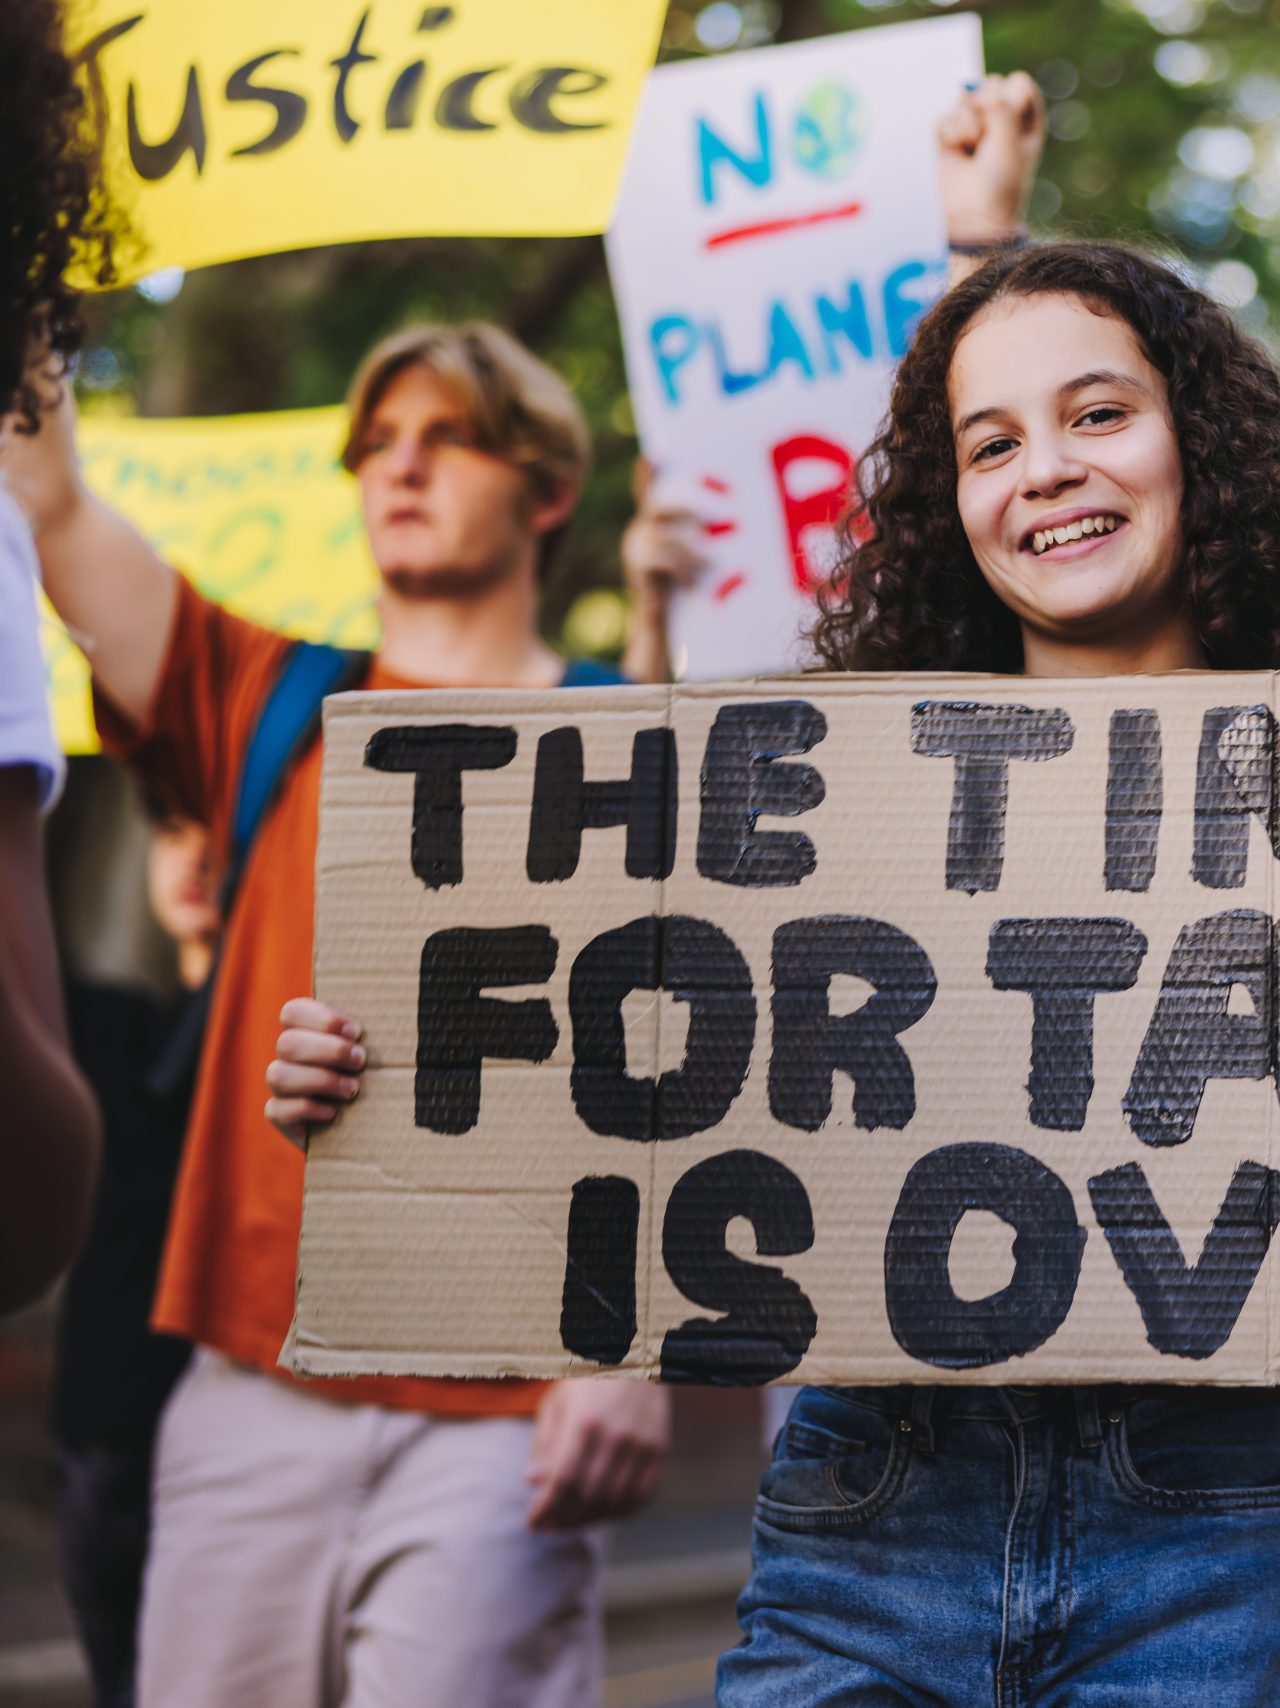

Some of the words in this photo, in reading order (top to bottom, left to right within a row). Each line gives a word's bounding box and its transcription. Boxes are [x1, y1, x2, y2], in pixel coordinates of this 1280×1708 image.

[648, 258, 946, 408] PLANE
[364, 700, 828, 890] THE
[414, 914, 938, 1142] FOR
[560, 1148, 818, 1386] IS
